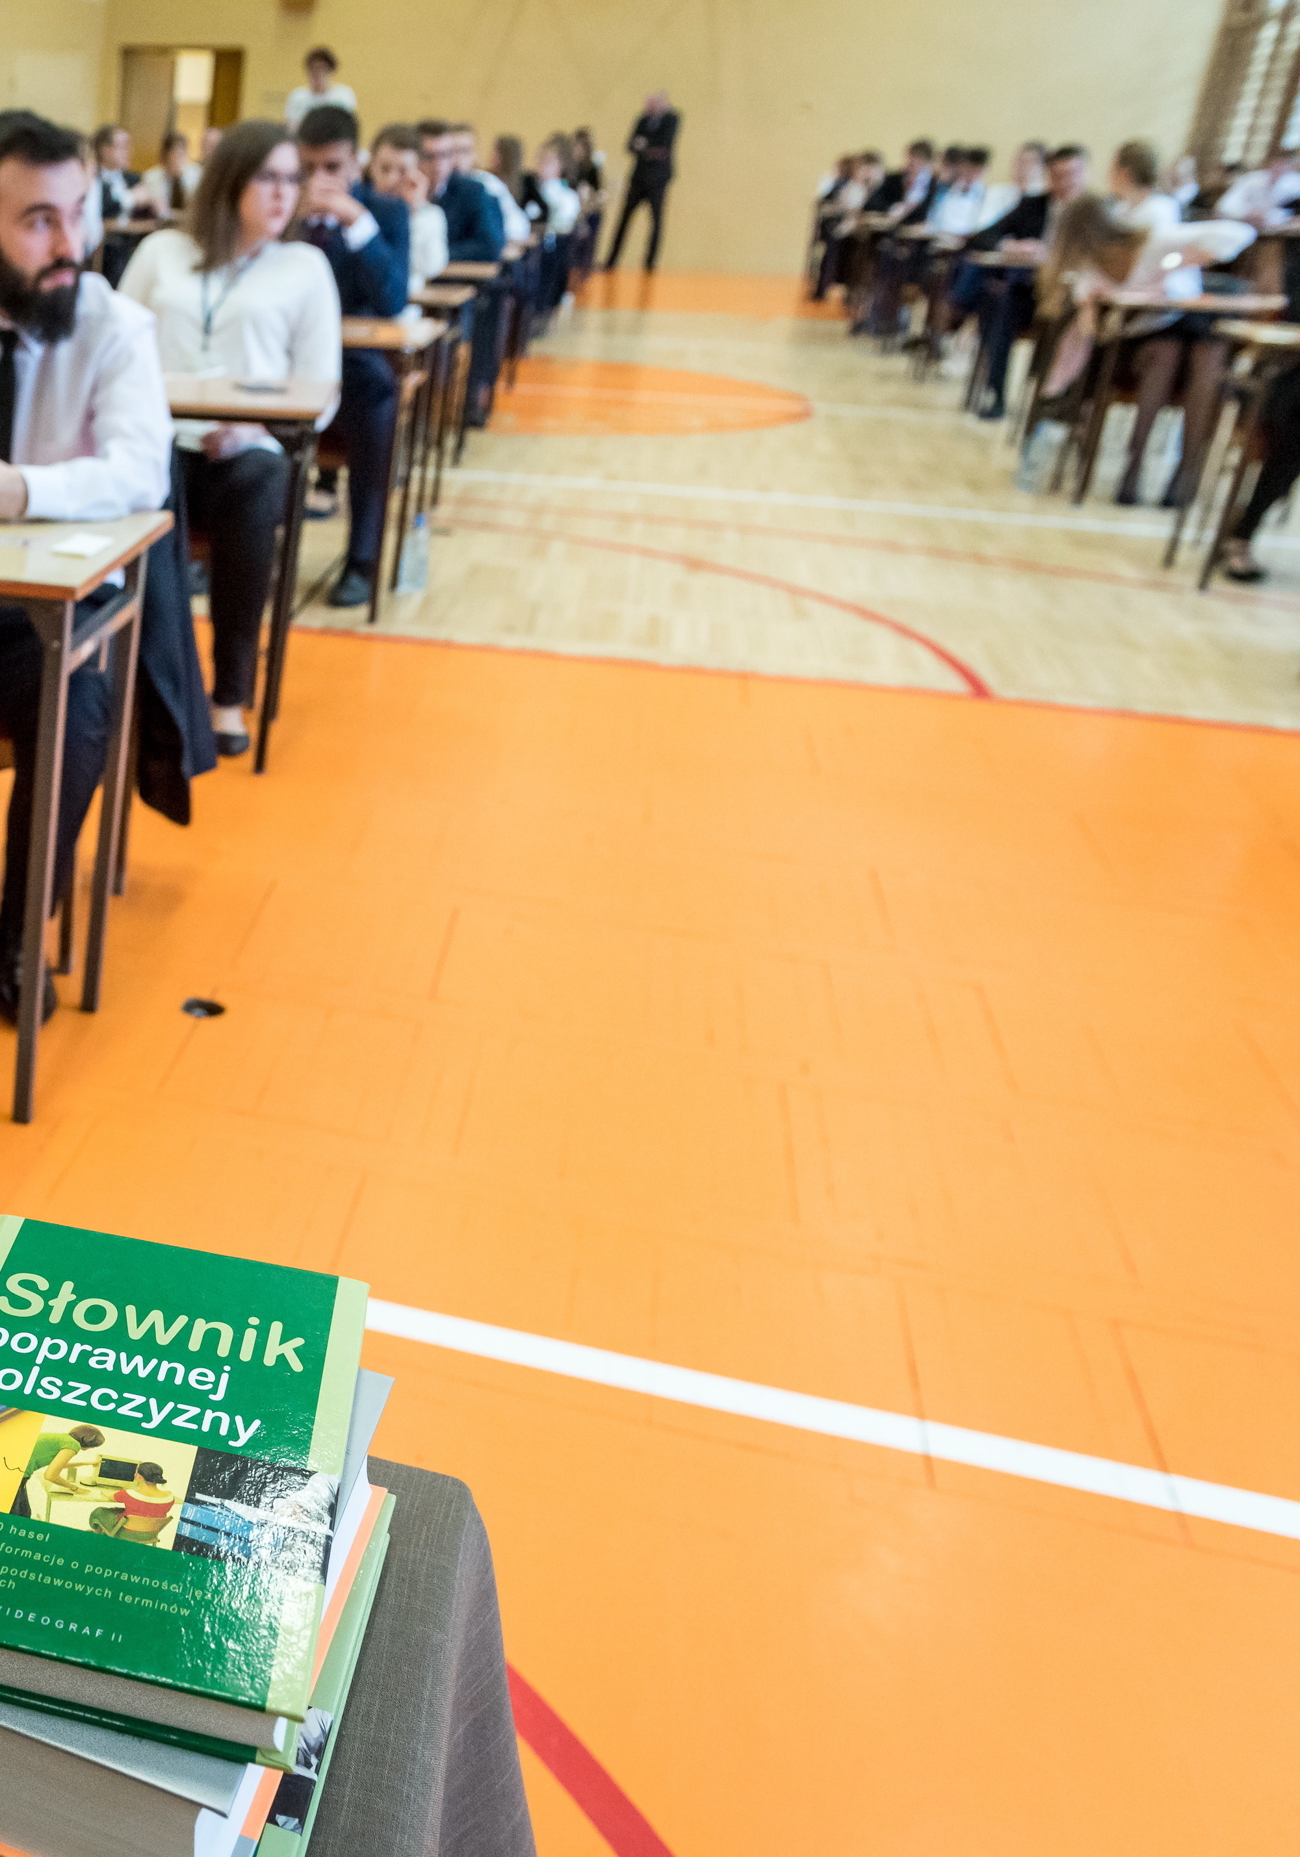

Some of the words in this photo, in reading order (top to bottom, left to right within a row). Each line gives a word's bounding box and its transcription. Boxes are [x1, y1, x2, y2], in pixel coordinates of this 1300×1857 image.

[0, 1564, 113, 1599] podstawowych
[118, 1590, 191, 1617] terminów
[70, 1559, 79, 1570] o
[84, 1563, 184, 1595] poprawności
